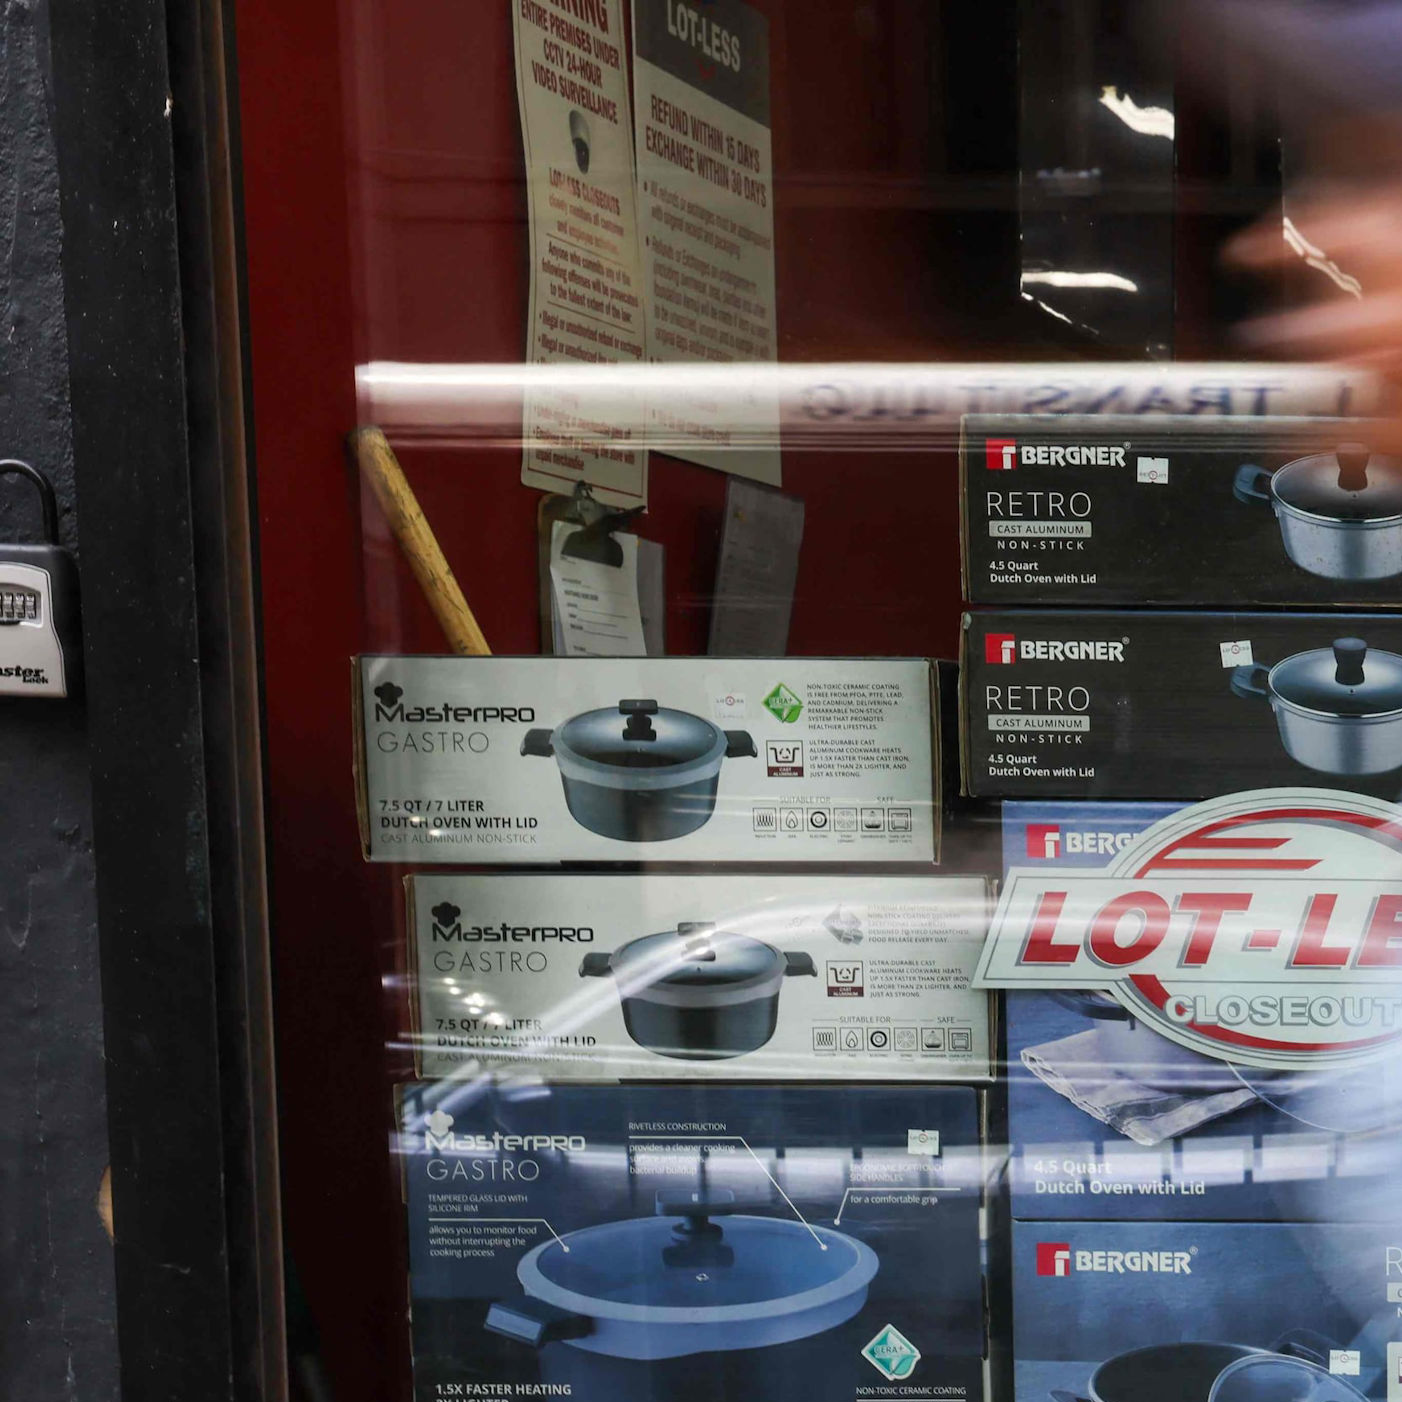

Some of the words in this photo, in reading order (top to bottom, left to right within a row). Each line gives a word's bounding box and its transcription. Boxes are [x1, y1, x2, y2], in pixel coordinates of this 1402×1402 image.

[521, 0, 548, 32] ENTIRE
[549, 12, 592, 55] PREMISES
[593, 36, 619, 71] UNDER
[667, 0, 740, 72] LOT-LESS
[544, 38, 564, 68] CCTV
[566, 50, 603, 89] 24-HOUR
[532, 60, 557, 94] VIDEO
[559, 75, 618, 125] SURVEILLANCE
[651, 94, 688, 136] REFUND
[691, 114, 723, 155] WITHIN
[726, 135, 735, 161] 15
[737, 140, 760, 174] DAYS
[646, 125, 694, 173] EXCHANGE
[697, 152, 729, 190] WITHIN
[732, 169, 741, 196] 30
[744, 175, 766, 208] DAYS
[1022, 446, 1126, 467] BERGNER
[987, 492, 1091, 517] RETRO
[997, 525, 1022, 534] CAST
[1026, 525, 1084, 534] ALUMINUM
[998, 541, 1084, 550] NON-STICK
[990, 561, 1005, 570] 4.5
[1008, 561, 1038, 571] Quart
[990, 574, 1021, 583] Dutch
[1024, 574, 1051, 583] Oven
[1054, 574, 1077, 583] with
[1081, 574, 1096, 583] Lid
[1020, 641, 1125, 662] BERGNER
[986, 686, 1089, 711] RETRO
[378, 732, 489, 753] GASTRO
[434, 952, 548, 973] GASTRO
[426, 1160, 540, 1182] GASTRO
[1075, 1250, 1193, 1274] BERGNER
[436, 1384, 462, 1395] 1.5X
[467, 1384, 512, 1395] FASTER
[516, 1385, 572, 1395] HEATING
